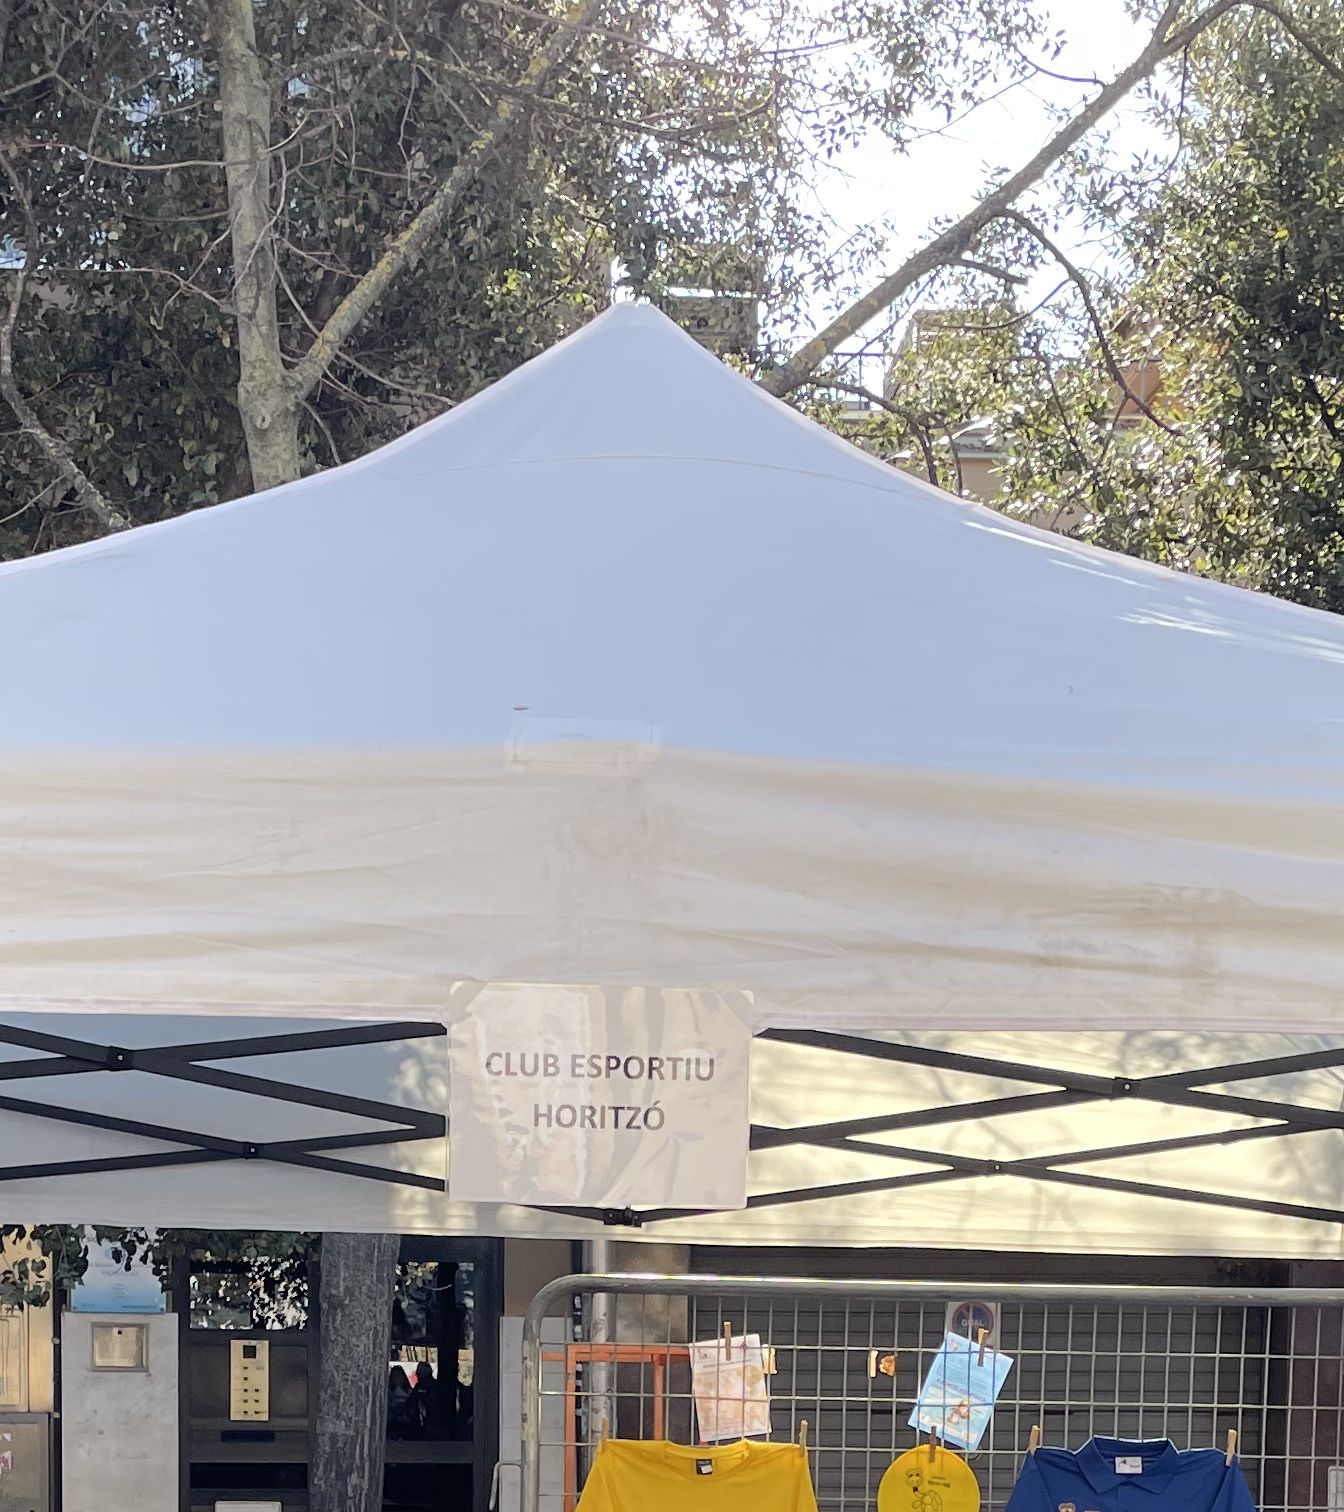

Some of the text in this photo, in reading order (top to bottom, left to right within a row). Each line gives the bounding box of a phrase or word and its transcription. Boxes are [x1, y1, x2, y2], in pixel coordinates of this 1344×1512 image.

[485, 1051, 715, 1082] CLUB ESPORTIU
[533, 1101, 666, 1132] HORITZÓ
